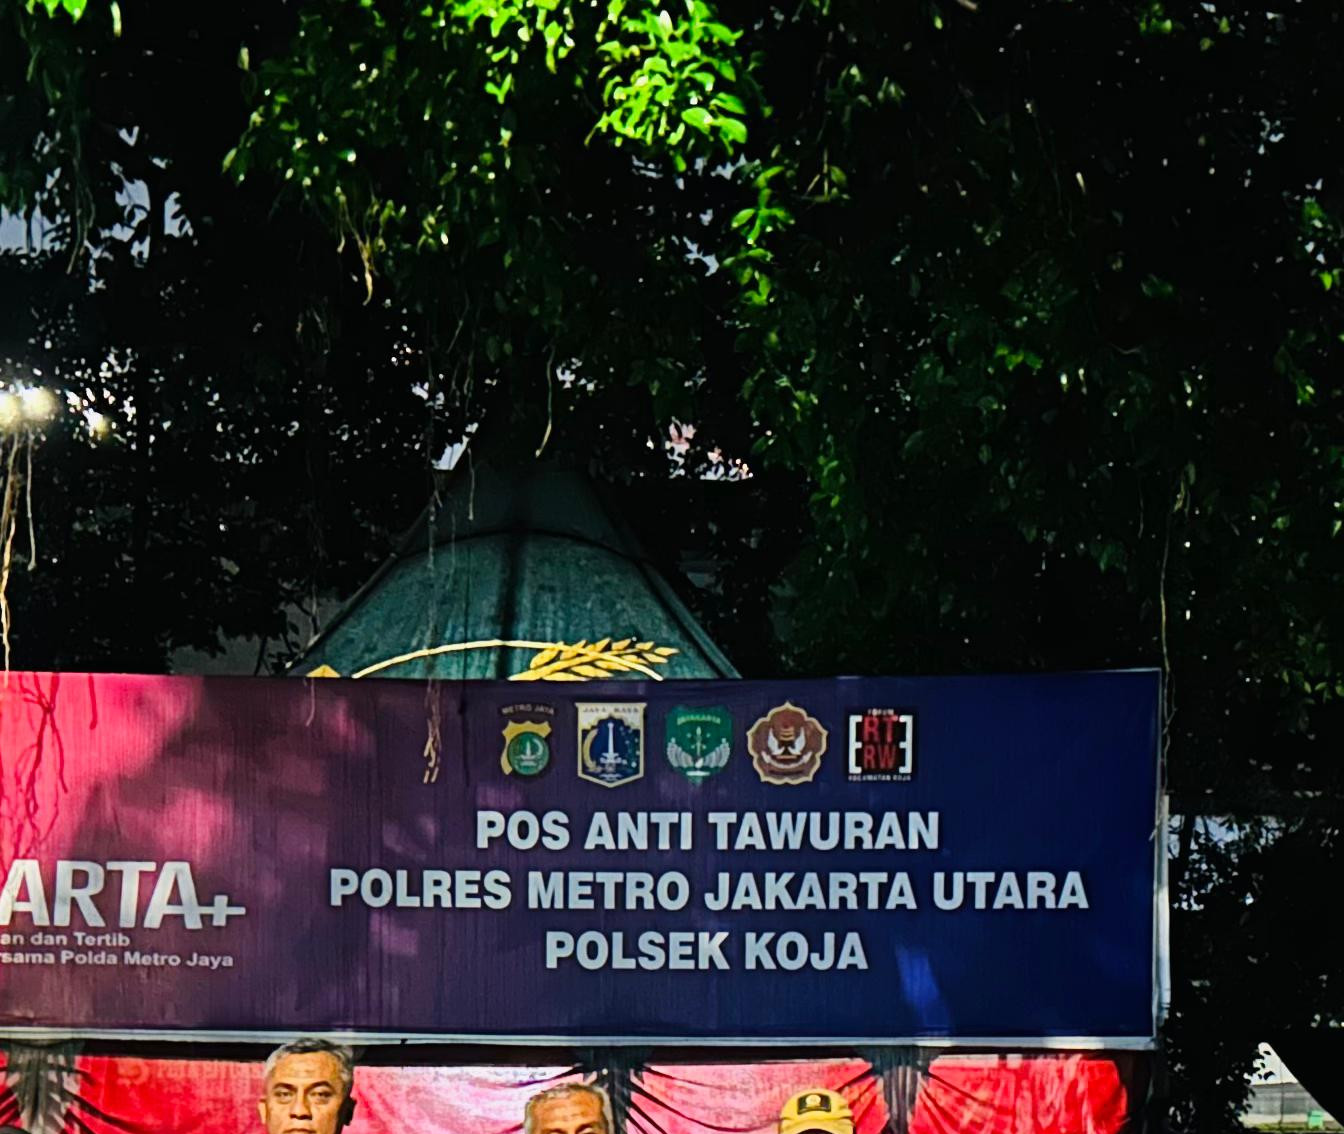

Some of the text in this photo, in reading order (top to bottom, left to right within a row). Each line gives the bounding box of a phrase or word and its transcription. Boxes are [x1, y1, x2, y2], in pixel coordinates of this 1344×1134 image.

[863, 715, 899, 743] RT
[863, 744, 897, 769] RW
[476, 811, 940, 850] POS ANTI TAWURAN
[330, 869, 1090, 911] POLRES METRO JAKARTA UTARA
[30, 930, 68, 947] dan
[73, 931, 130, 947] Tertib
[545, 931, 869, 970] POLSEK KOJA
[60, 949, 118, 966] Polda
[123, 950, 181, 967] Metro
[186, 952, 234, 971] Jaya
